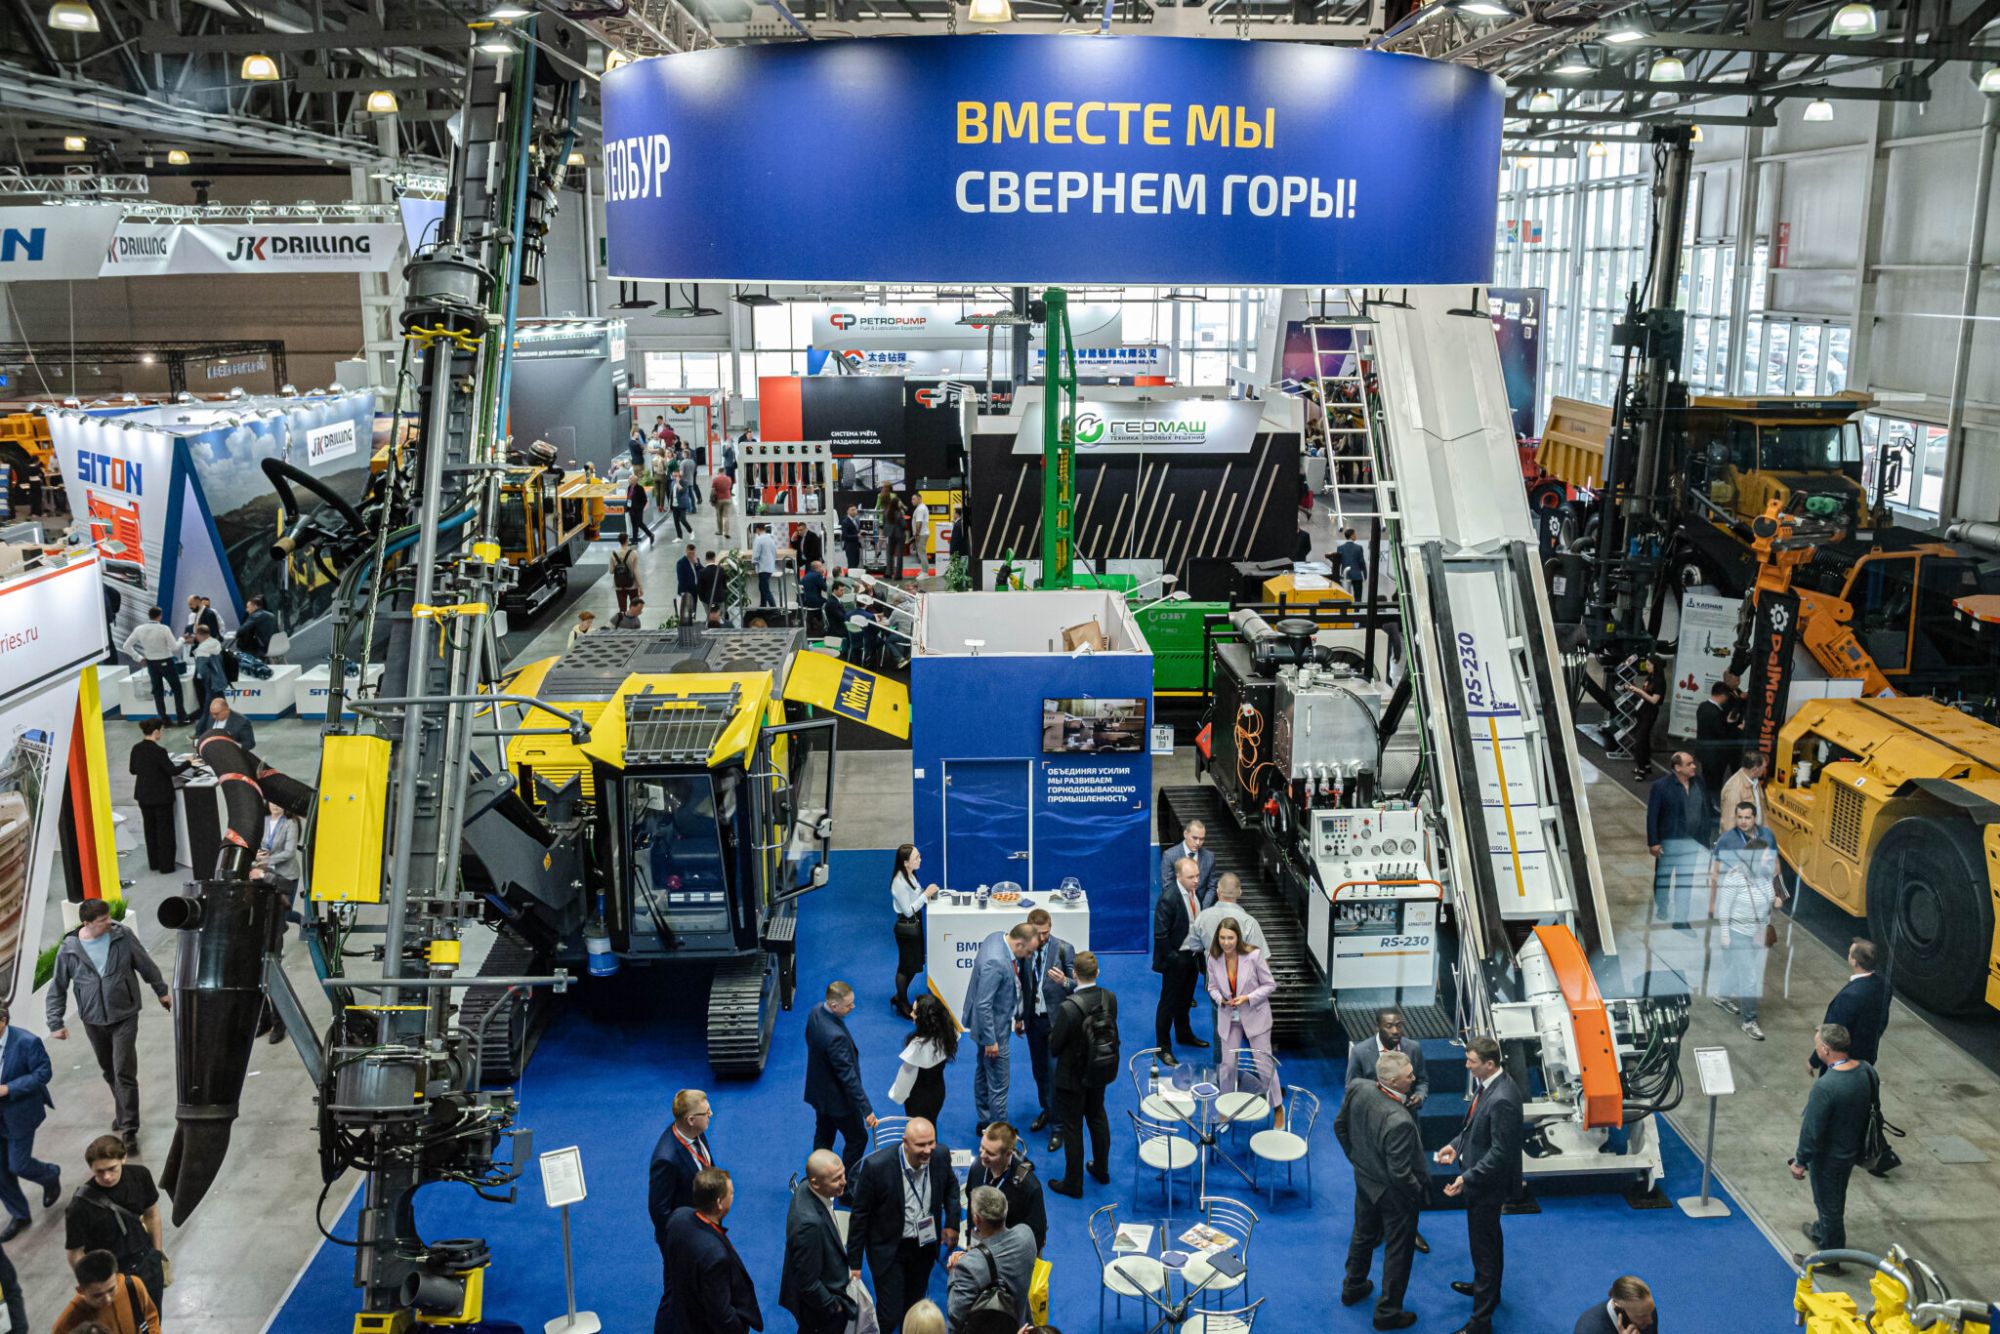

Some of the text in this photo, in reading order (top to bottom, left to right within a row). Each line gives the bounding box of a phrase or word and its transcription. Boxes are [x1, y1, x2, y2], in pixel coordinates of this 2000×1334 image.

[957, 101, 1276, 149] ВМЕСТЕ МЫ
[603, 134, 671, 203] ГЕОБУР
[955, 170, 1358, 219] СВЕРНЕМ ГОРЫ!
[119, 236, 167, 255] DRILLING
[226, 235, 370, 261] JK DRILLING
[860, 317, 927, 325] PETROPUMP
[859, 429, 877, 437] УЧЁТА
[1110, 420, 1206, 433] ГЕОМАШ
[324, 428, 353, 448] DRILLING
[77, 449, 143, 497] SITON
[1457, 632, 1485, 708] RS-230
[841, 675, 872, 713] Nitrox
[1759, 633, 1783, 755] DalMachin
[1047, 767, 1130, 776] ОБЪЕДИНЯЯ УСИЛИЯ
[1064, 777, 1112, 785] РАЗВИВАЕМ
[1047, 785, 1136, 795] ГОРНОДОБЫВАЮЩУЮ
[1047, 794, 1128, 803] ПРОМЫШЛЕННОСТЬ
[1380, 936, 1430, 948] RS-230
